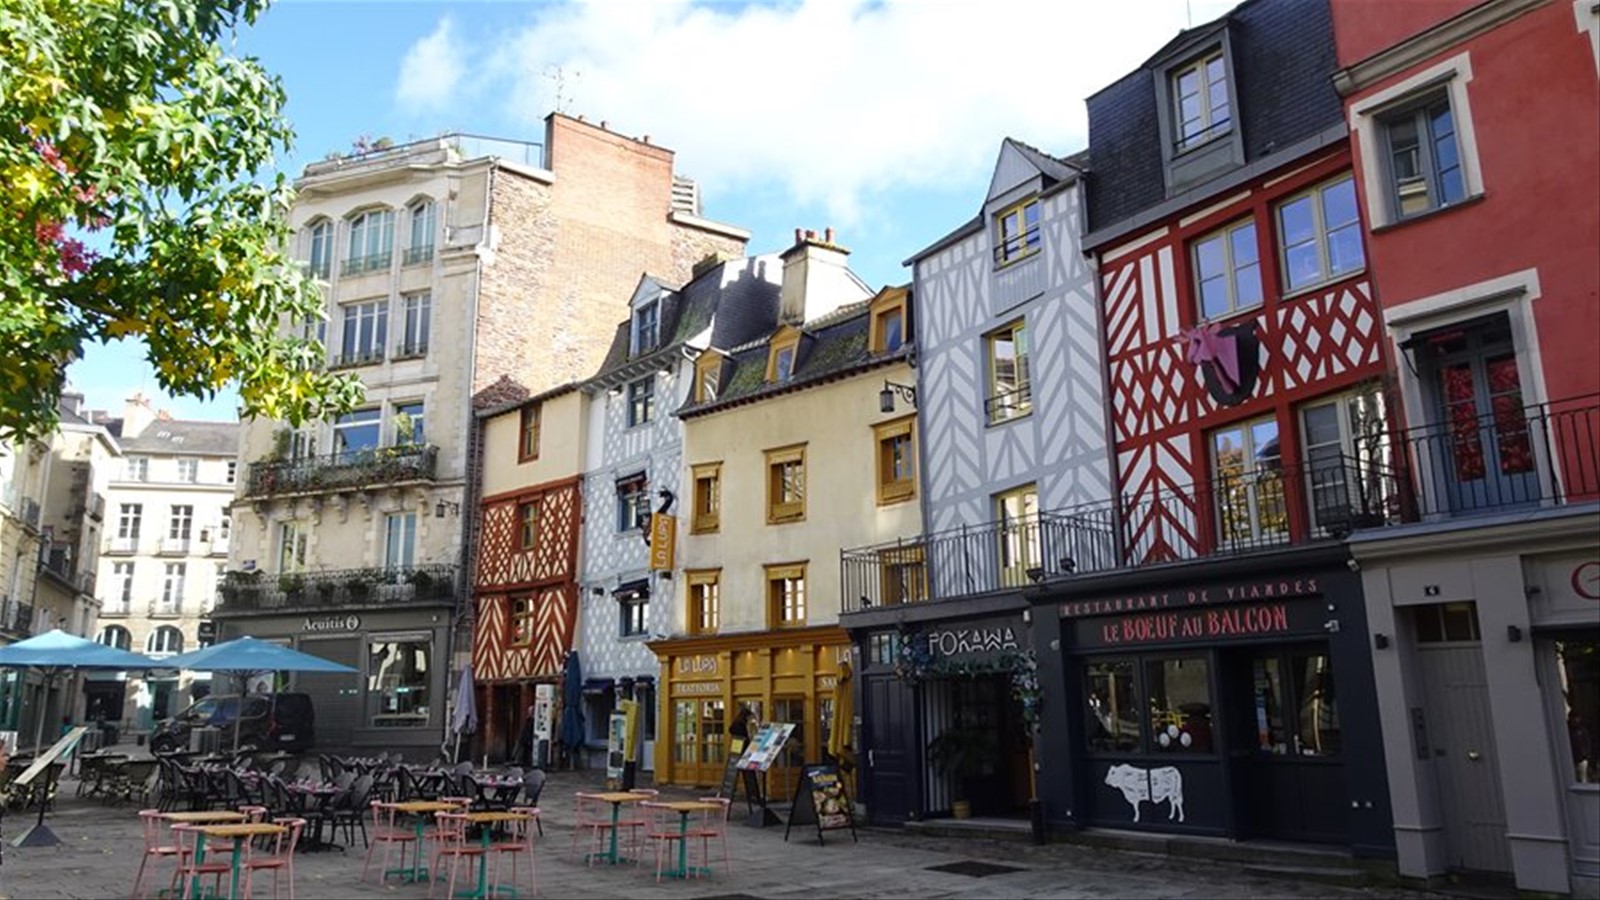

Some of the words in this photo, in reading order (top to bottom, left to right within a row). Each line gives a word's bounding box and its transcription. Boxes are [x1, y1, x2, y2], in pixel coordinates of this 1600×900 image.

[1063, 594, 1169, 616] RESTAURANT
[1187, 590, 1209, 604] DE
[1227, 579, 1318, 600] VIANDES
[302, 616, 345, 630] Acuitis
[1103, 624, 1120, 642] LE
[1181, 617, 1203, 637] AU
[1207, 605, 1289, 635] BALCON
[928, 627, 1018, 656] POKAWA
